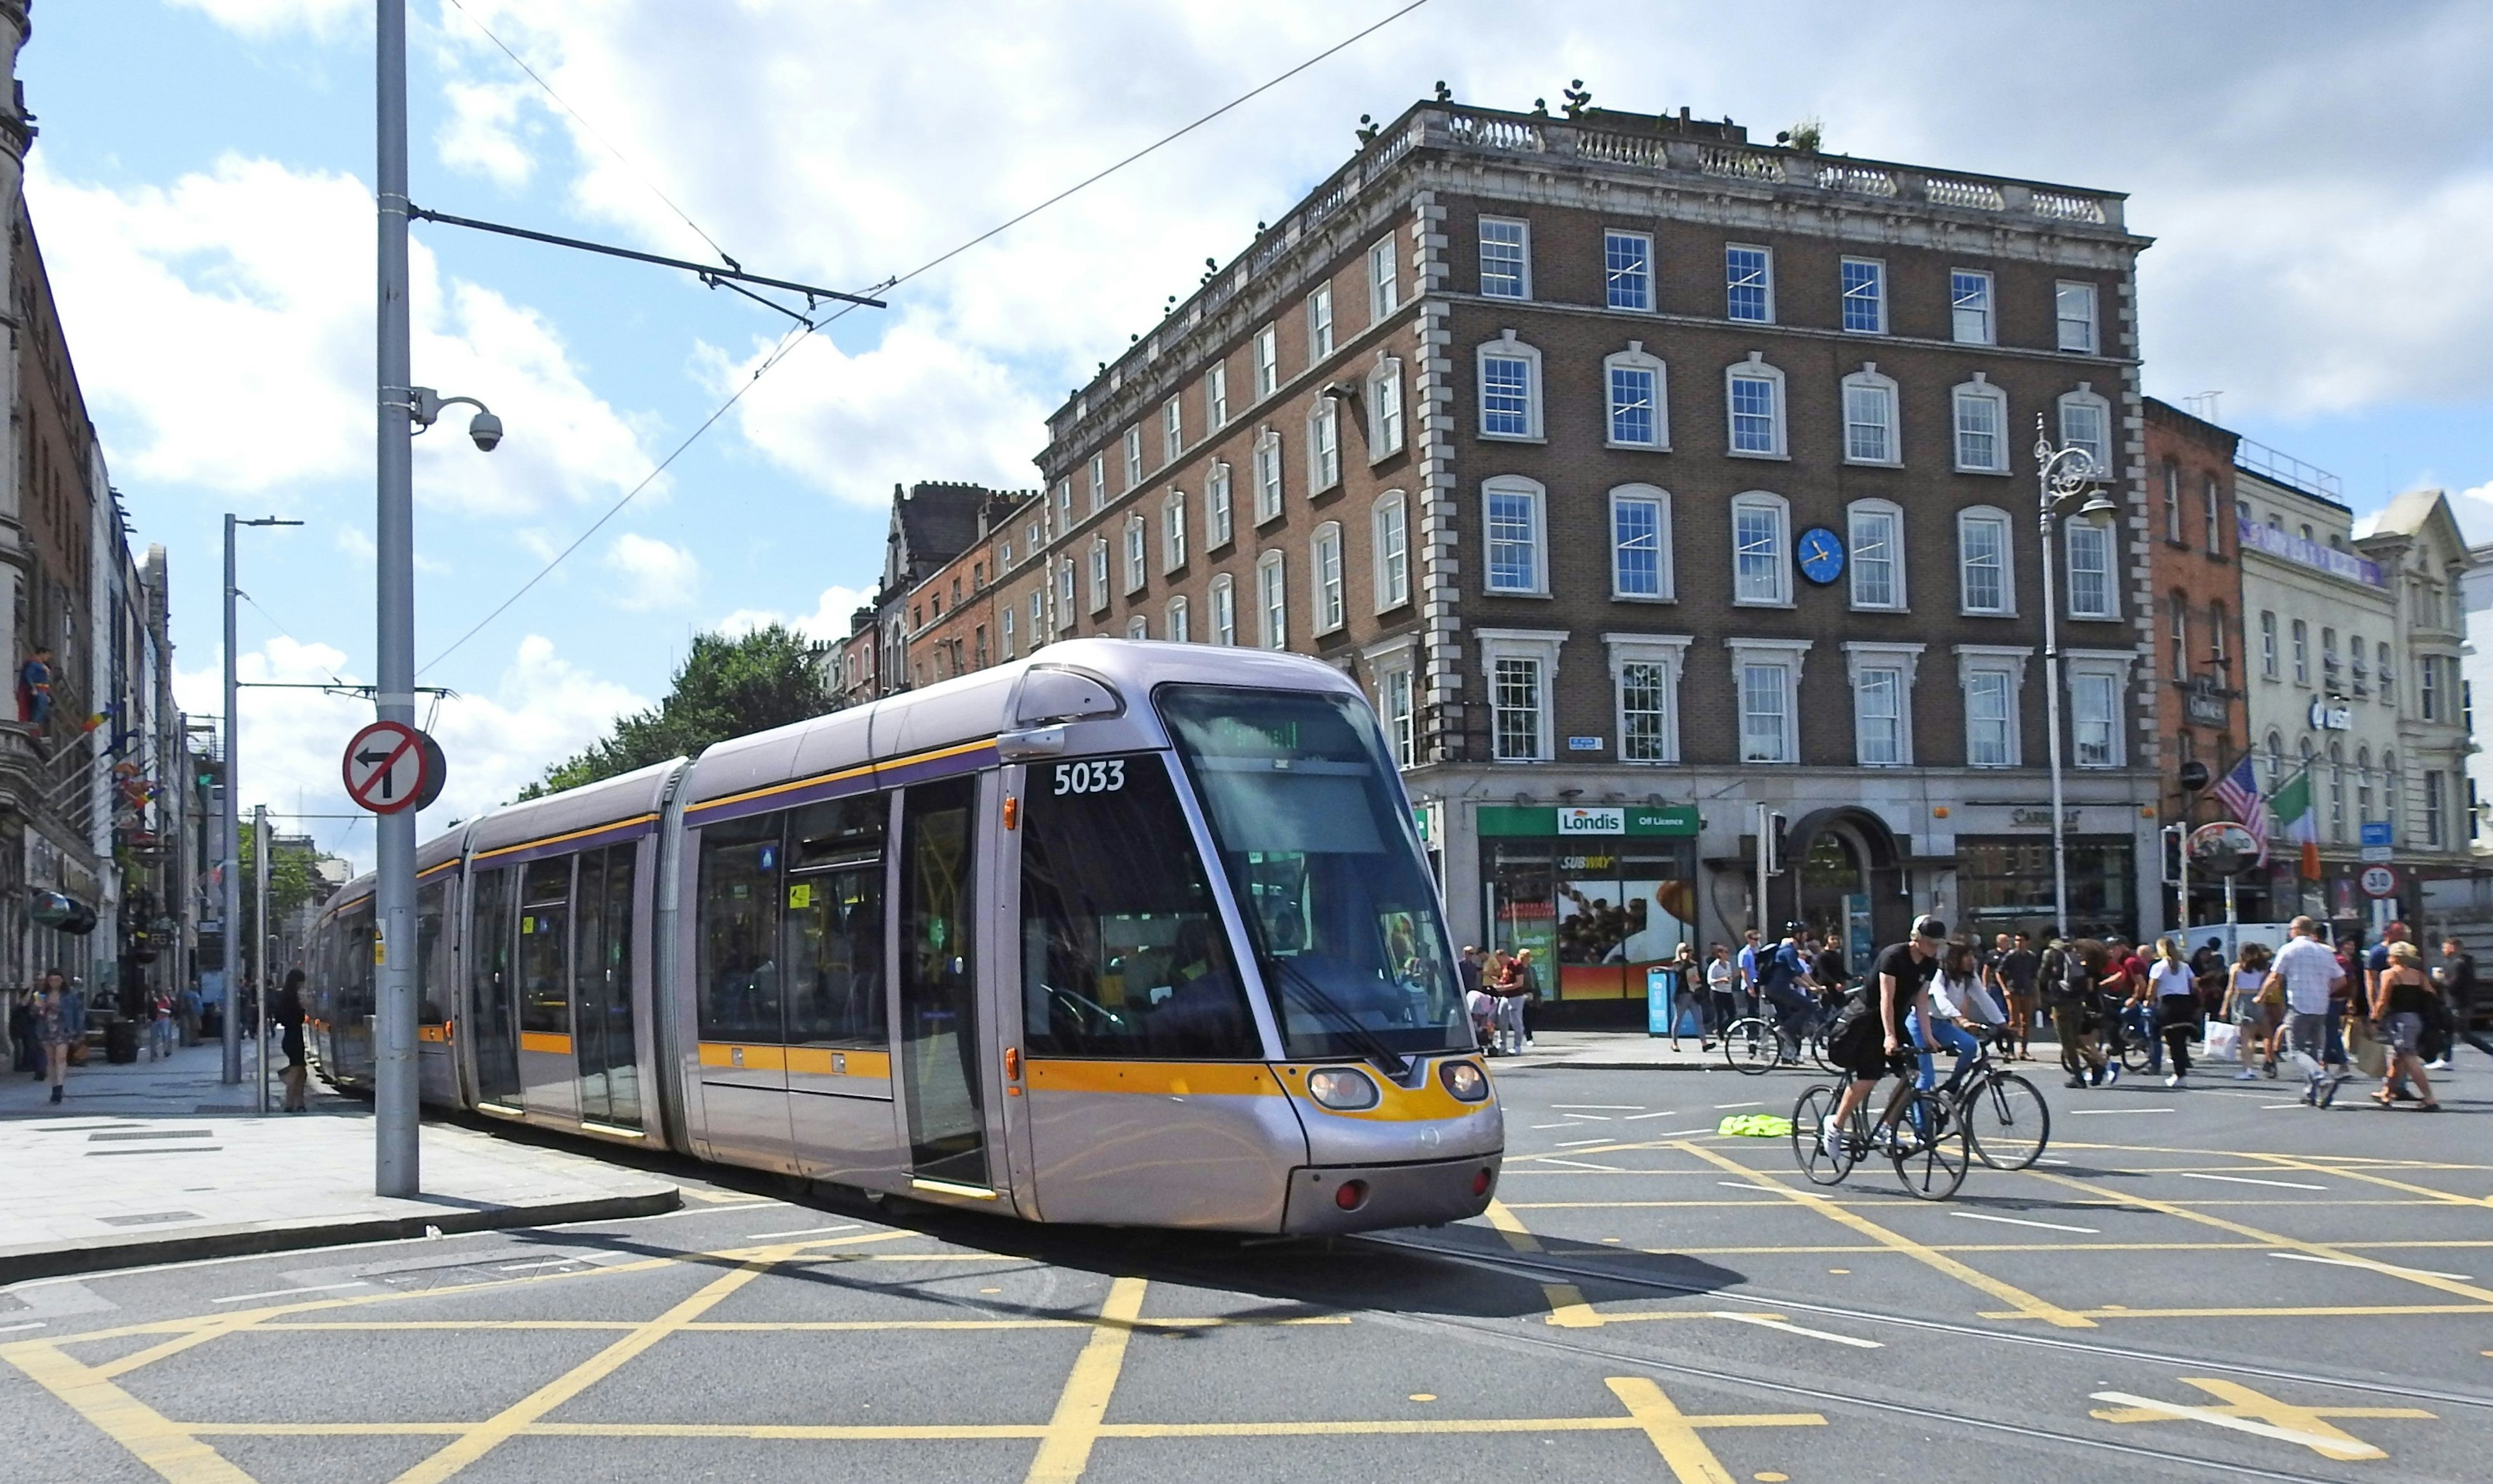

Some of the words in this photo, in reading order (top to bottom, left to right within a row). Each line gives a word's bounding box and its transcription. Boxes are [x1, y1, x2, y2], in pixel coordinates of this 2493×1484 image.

[1054, 760, 1124, 795] 5033
[1563, 813, 1619, 830] Londis
[1639, 817, 1652, 826] Off
[1654, 817, 1684, 826] Licence
[1560, 855, 1615, 869] SUBWAY
[2368, 872, 2390, 887] 30
